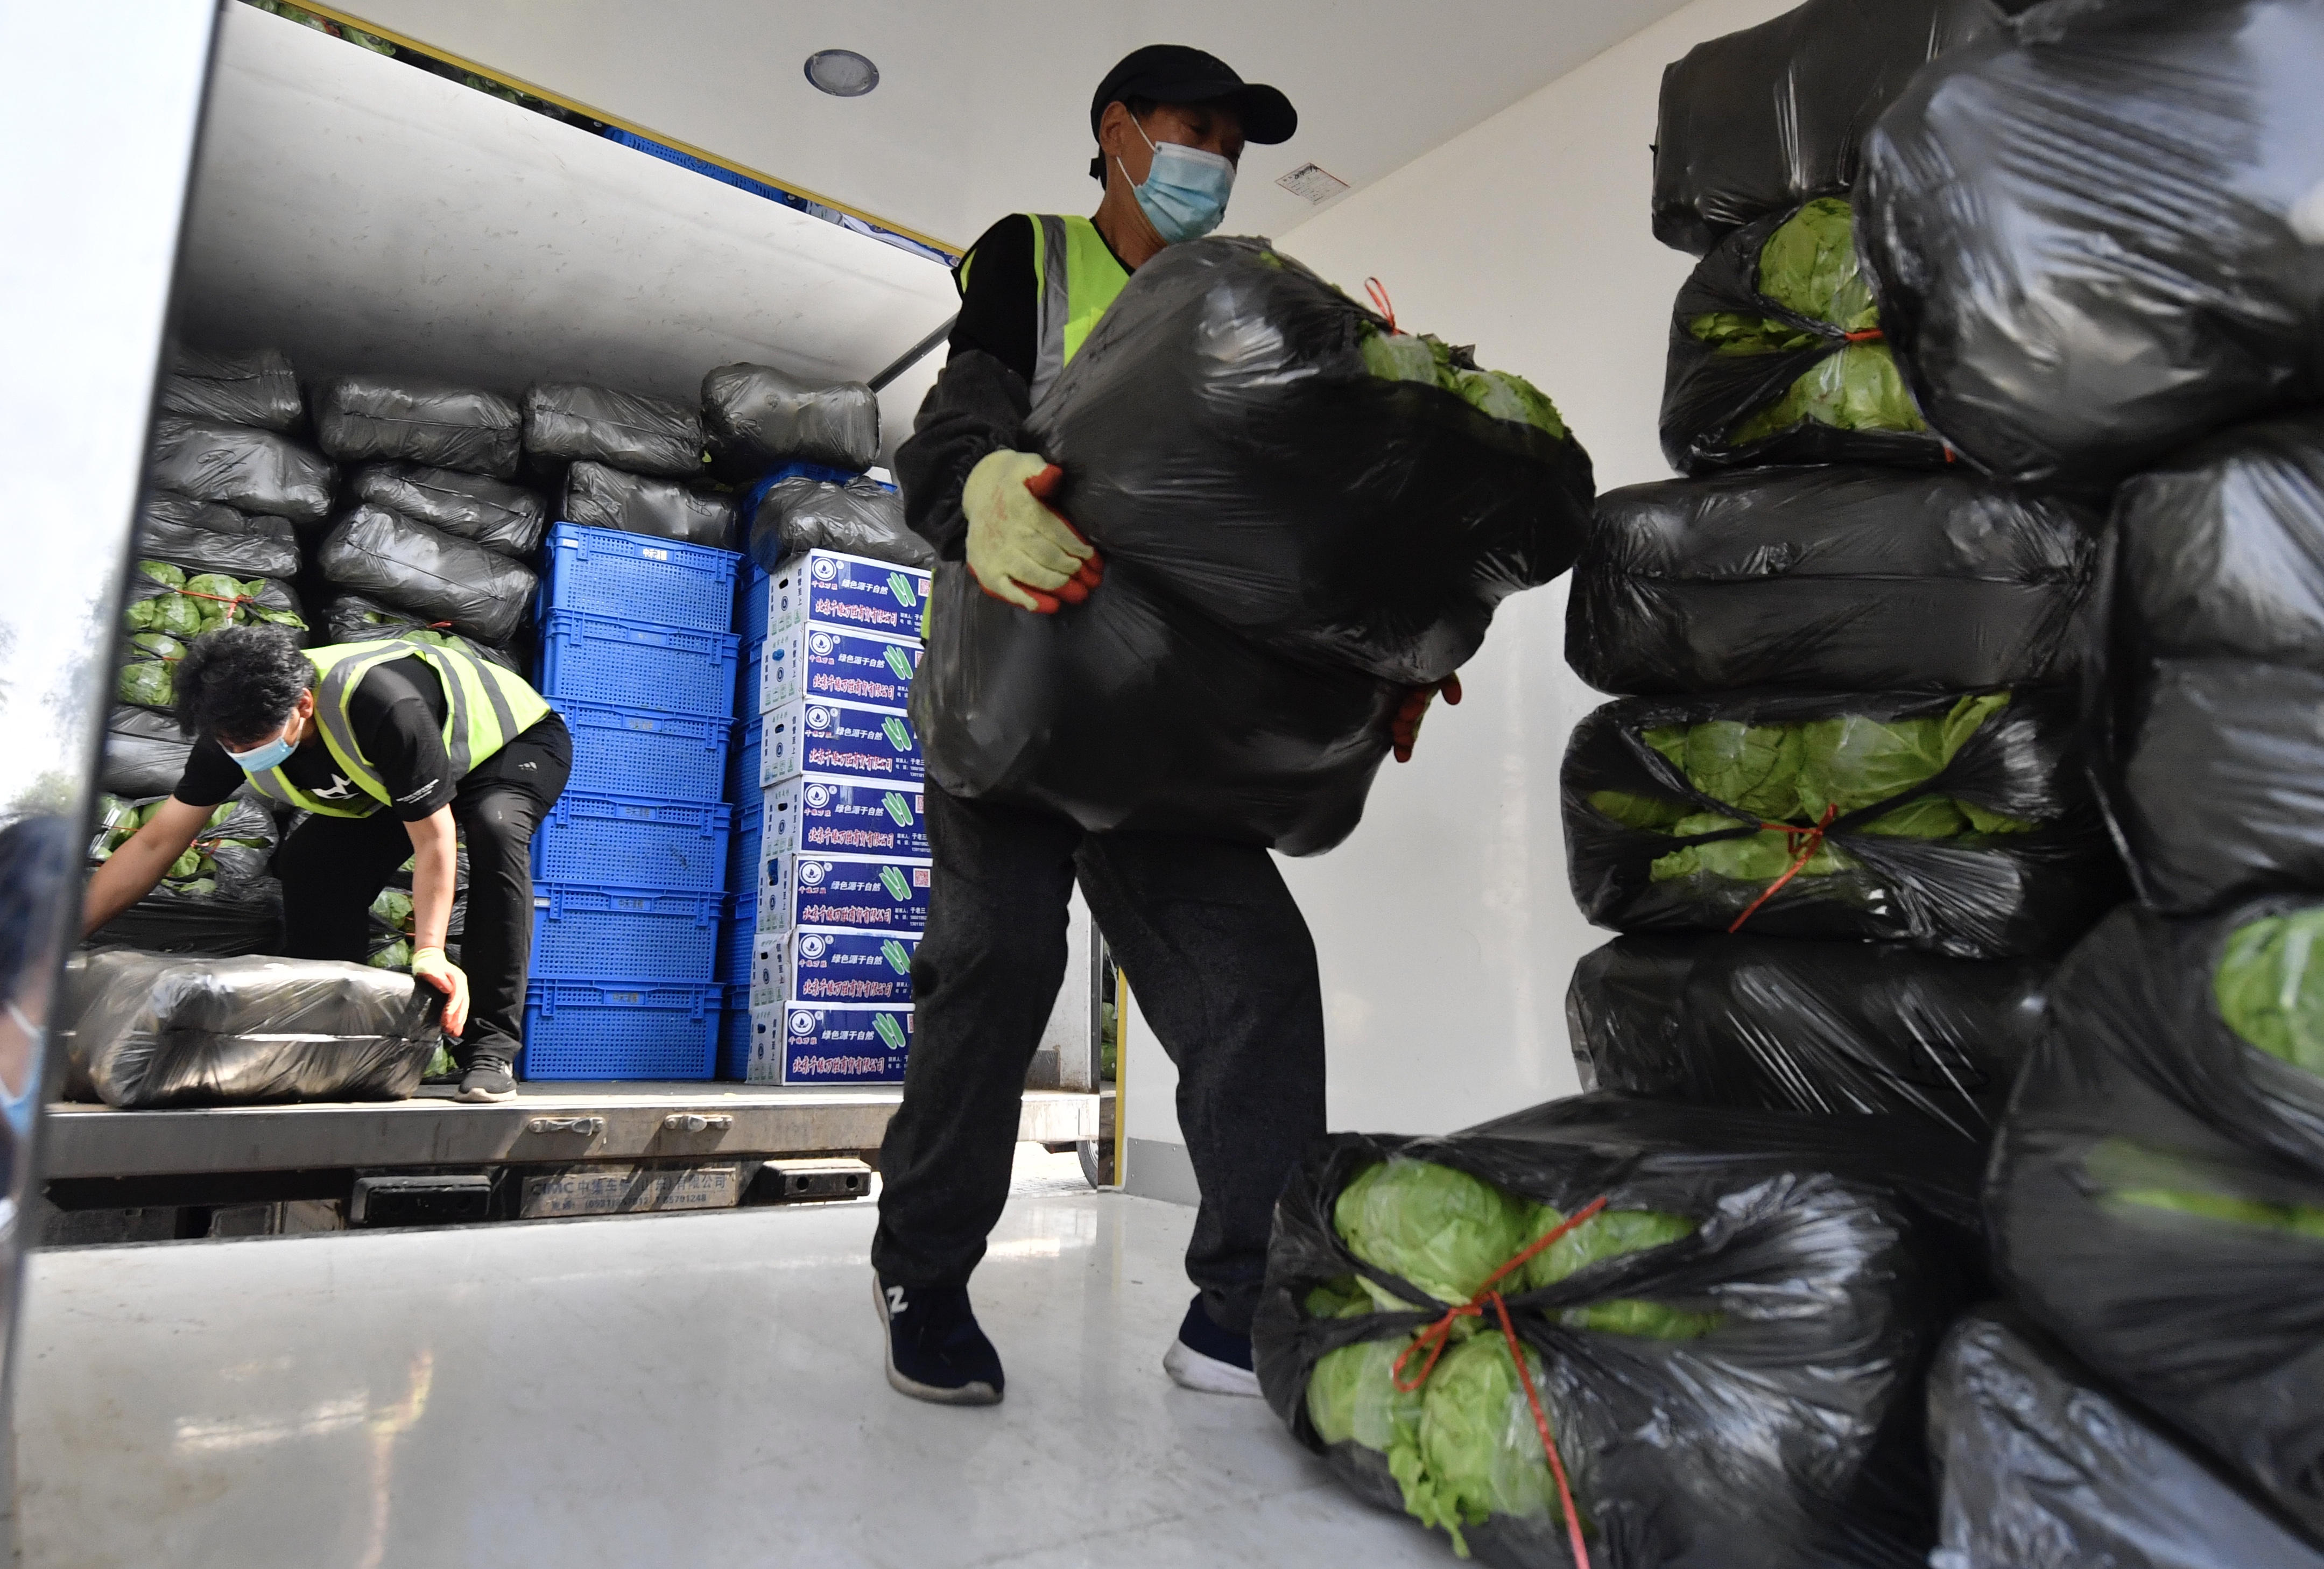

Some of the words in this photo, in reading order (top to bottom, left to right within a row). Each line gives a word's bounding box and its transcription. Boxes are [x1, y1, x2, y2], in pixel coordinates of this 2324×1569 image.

[841, 579, 889, 595] 绿色源于自然
[838, 653, 885, 669] 绿色源于自然
[836, 727, 883, 741] 绿色源于自然
[835, 804, 884, 817] 绿色源于自然
[830, 881, 881, 892] 绿色源于自然
[831, 954, 883, 965] 绿色源于自然
[821, 1030, 875, 1040] 绿色源于自然
